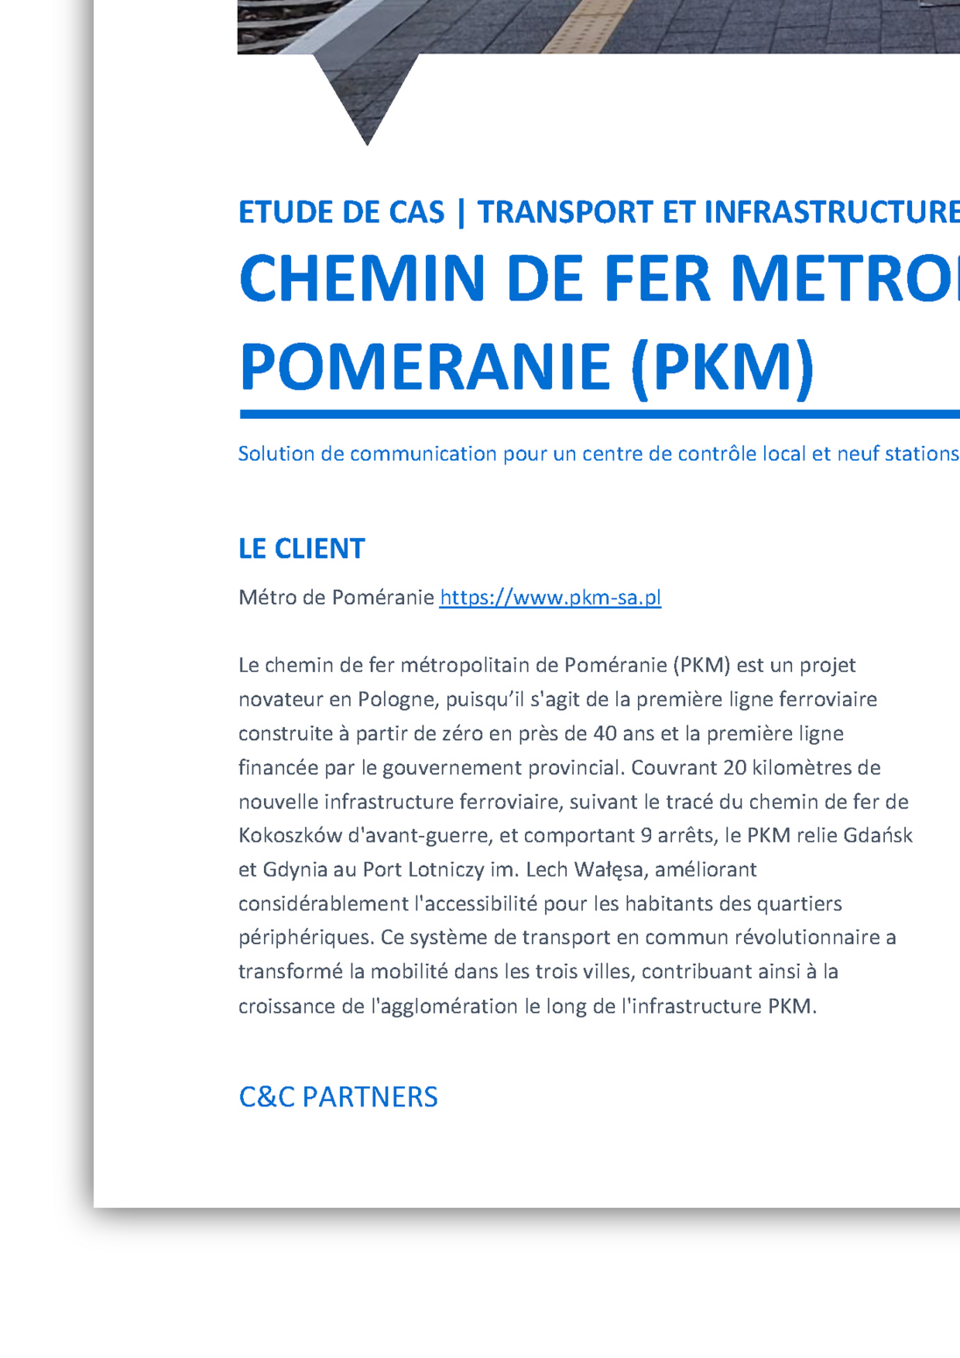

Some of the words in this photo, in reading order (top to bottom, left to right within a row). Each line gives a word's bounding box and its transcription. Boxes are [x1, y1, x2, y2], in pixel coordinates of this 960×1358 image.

[240, 200, 332, 224] ETUDE
[344, 200, 379, 223] DE
[390, 200, 444, 224] CAS
[477, 200, 654, 224] TRANSPORT
[664, 200, 696, 223] ET
[241, 254, 483, 302] CHEMIN
[509, 255, 582, 301] DE
[607, 255, 711, 301] FER
[243, 342, 609, 390] POMERANIE
[632, 339, 812, 402] (PKM)
[239, 445, 314, 461] Solution
[322, 445, 344, 461] de
[351, 446, 496, 461] communication
[505, 449, 547, 465] pour
[554, 449, 575, 461] un
[583, 447, 642, 461] centre
[650, 445, 672, 461] de
[679, 444, 756, 461] contrôle
[764, 445, 805, 461] local
[813, 447, 831, 461] et
[839, 444, 880, 461] neuf
[886, 446, 959, 461] stations
[240, 538, 266, 558] LE
[276, 537, 365, 558] CLIENT
[240, 588, 296, 604] Métro
[304, 589, 325, 604] de
[334, 588, 434, 604] Poméranie
[439, 587, 662, 609] https://www.pkm-sa.pl
[240, 657, 258, 672] Le
[266, 657, 332, 672] chemin
[341, 657, 362, 672] de
[369, 656, 394, 672] fer
[402, 656, 528, 676] métropolitain
[537, 657, 558, 672] de
[566, 656, 667, 672] Poméranie
[674, 656, 729, 676] (PKM)
[738, 659, 763, 672] est
[771, 661, 792, 672] un
[801, 657, 856, 676] projet
[239, 726, 332, 740] construite
[340, 725, 348, 740] à
[357, 726, 408, 744] partir
[415, 725, 436, 740] de
[443, 724, 482, 740] zéro
[490, 729, 511, 740] en
[520, 725, 558, 745] près
[565, 725, 586, 740] de
[594, 726, 616, 740] 40
[624, 729, 654, 740] ans
[662, 727, 678, 740] et
[687, 725, 699, 740] la
[708, 725, 792, 744] première
[800, 725, 843, 745] ligne
[240, 793, 318, 809] nouvelle
[325, 793, 453, 809] infrastructure
[460, 793, 563, 812] ferroviaire,
[570, 794, 637, 809] suivant
[646, 793, 659, 809] le
[667, 793, 713, 809] tracé
[720, 793, 742, 809] du
[750, 793, 817, 809] chemin
[825, 794, 847, 809] de
[854, 793, 879, 809] fer
[886, 793, 908, 809] de
[240, 826, 342, 842] Kokoszków
[500, 829, 518, 842] et
[525, 829, 634, 846] comportant
[641, 828, 651, 842] 9
[659, 826, 718, 846] arrêts,
[726, 827, 741, 842] le
[749, 828, 789, 842] PKM
[798, 827, 837, 842] relie
[844, 826, 912, 842] Gdańsk
[239, 863, 256, 877] et
[264, 861, 327, 881] Gdynia
[334, 865, 355, 877] au
[364, 862, 401, 877] Port
[410, 862, 484, 881] Lotniczy
[491, 862, 518, 876] im.
[528, 861, 567, 876] Lech
[574, 861, 648, 881] Wałęsa,
[656, 860, 756, 877] améliorant
[239, 998, 334, 1013] croissance
[343, 998, 364, 1013] de
[526, 998, 540, 1013] le
[548, 998, 586, 1017] long
[594, 998, 615, 1013] de
[770, 998, 816, 1013] PKM.
[240, 1085, 294, 1107] C&C
[304, 1086, 437, 1107] PARTNERS
